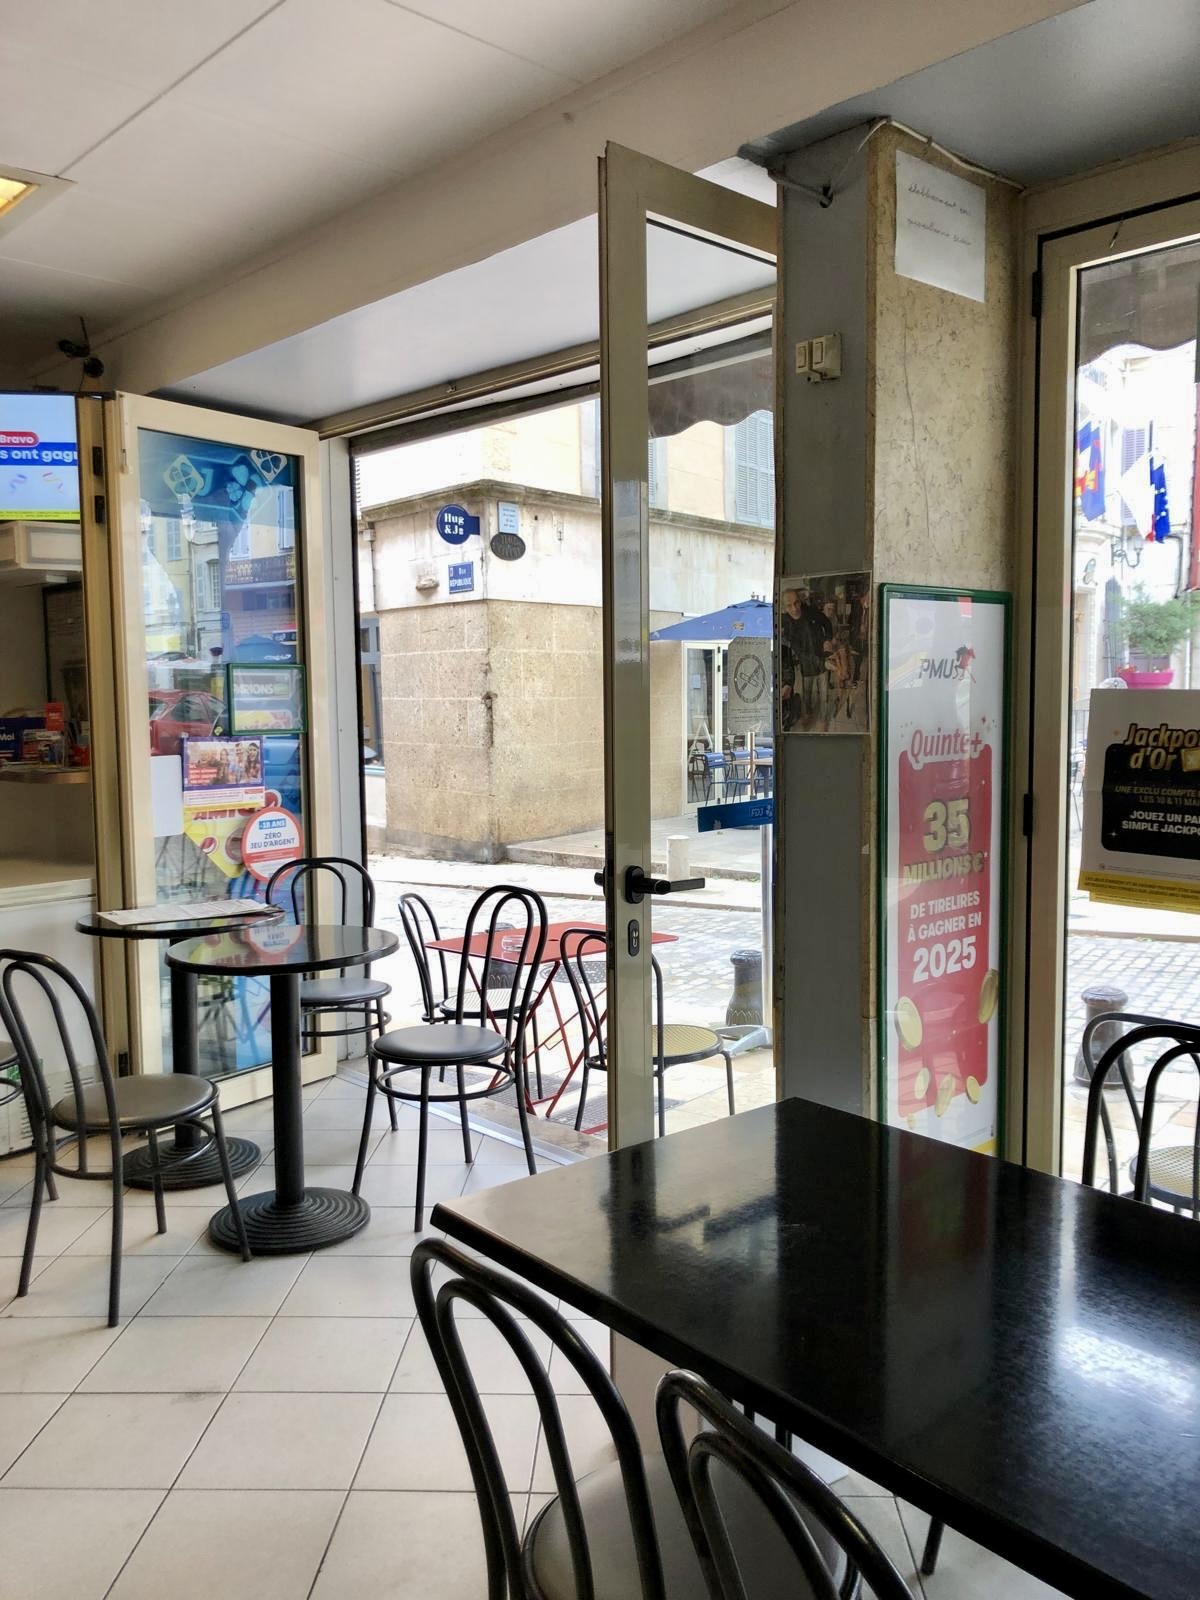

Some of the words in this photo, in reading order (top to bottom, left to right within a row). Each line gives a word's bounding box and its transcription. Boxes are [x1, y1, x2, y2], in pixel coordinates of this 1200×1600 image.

[0, 434, 34, 444] Bravo
[11, 449, 39, 460] ont
[918, 658, 954, 680] PMU
[1124, 723, 1200, 752] Jackpo
[923, 798, 970, 853] 35
[1122, 820, 1159, 832] SIMPLE
[1129, 810, 1165, 821] JOUEZ
[1166, 813, 1182, 823] UN
[1184, 815, 1200, 824] PA
[903, 856, 972, 884] MILLIONS
[910, 903, 926, 920] DE
[928, 890, 980, 915] TIRELIRES
[907, 923, 917, 944] À
[918, 917, 966, 940] GAGNER
[968, 911, 982, 928] EN
[912, 935, 977, 984] 2025
